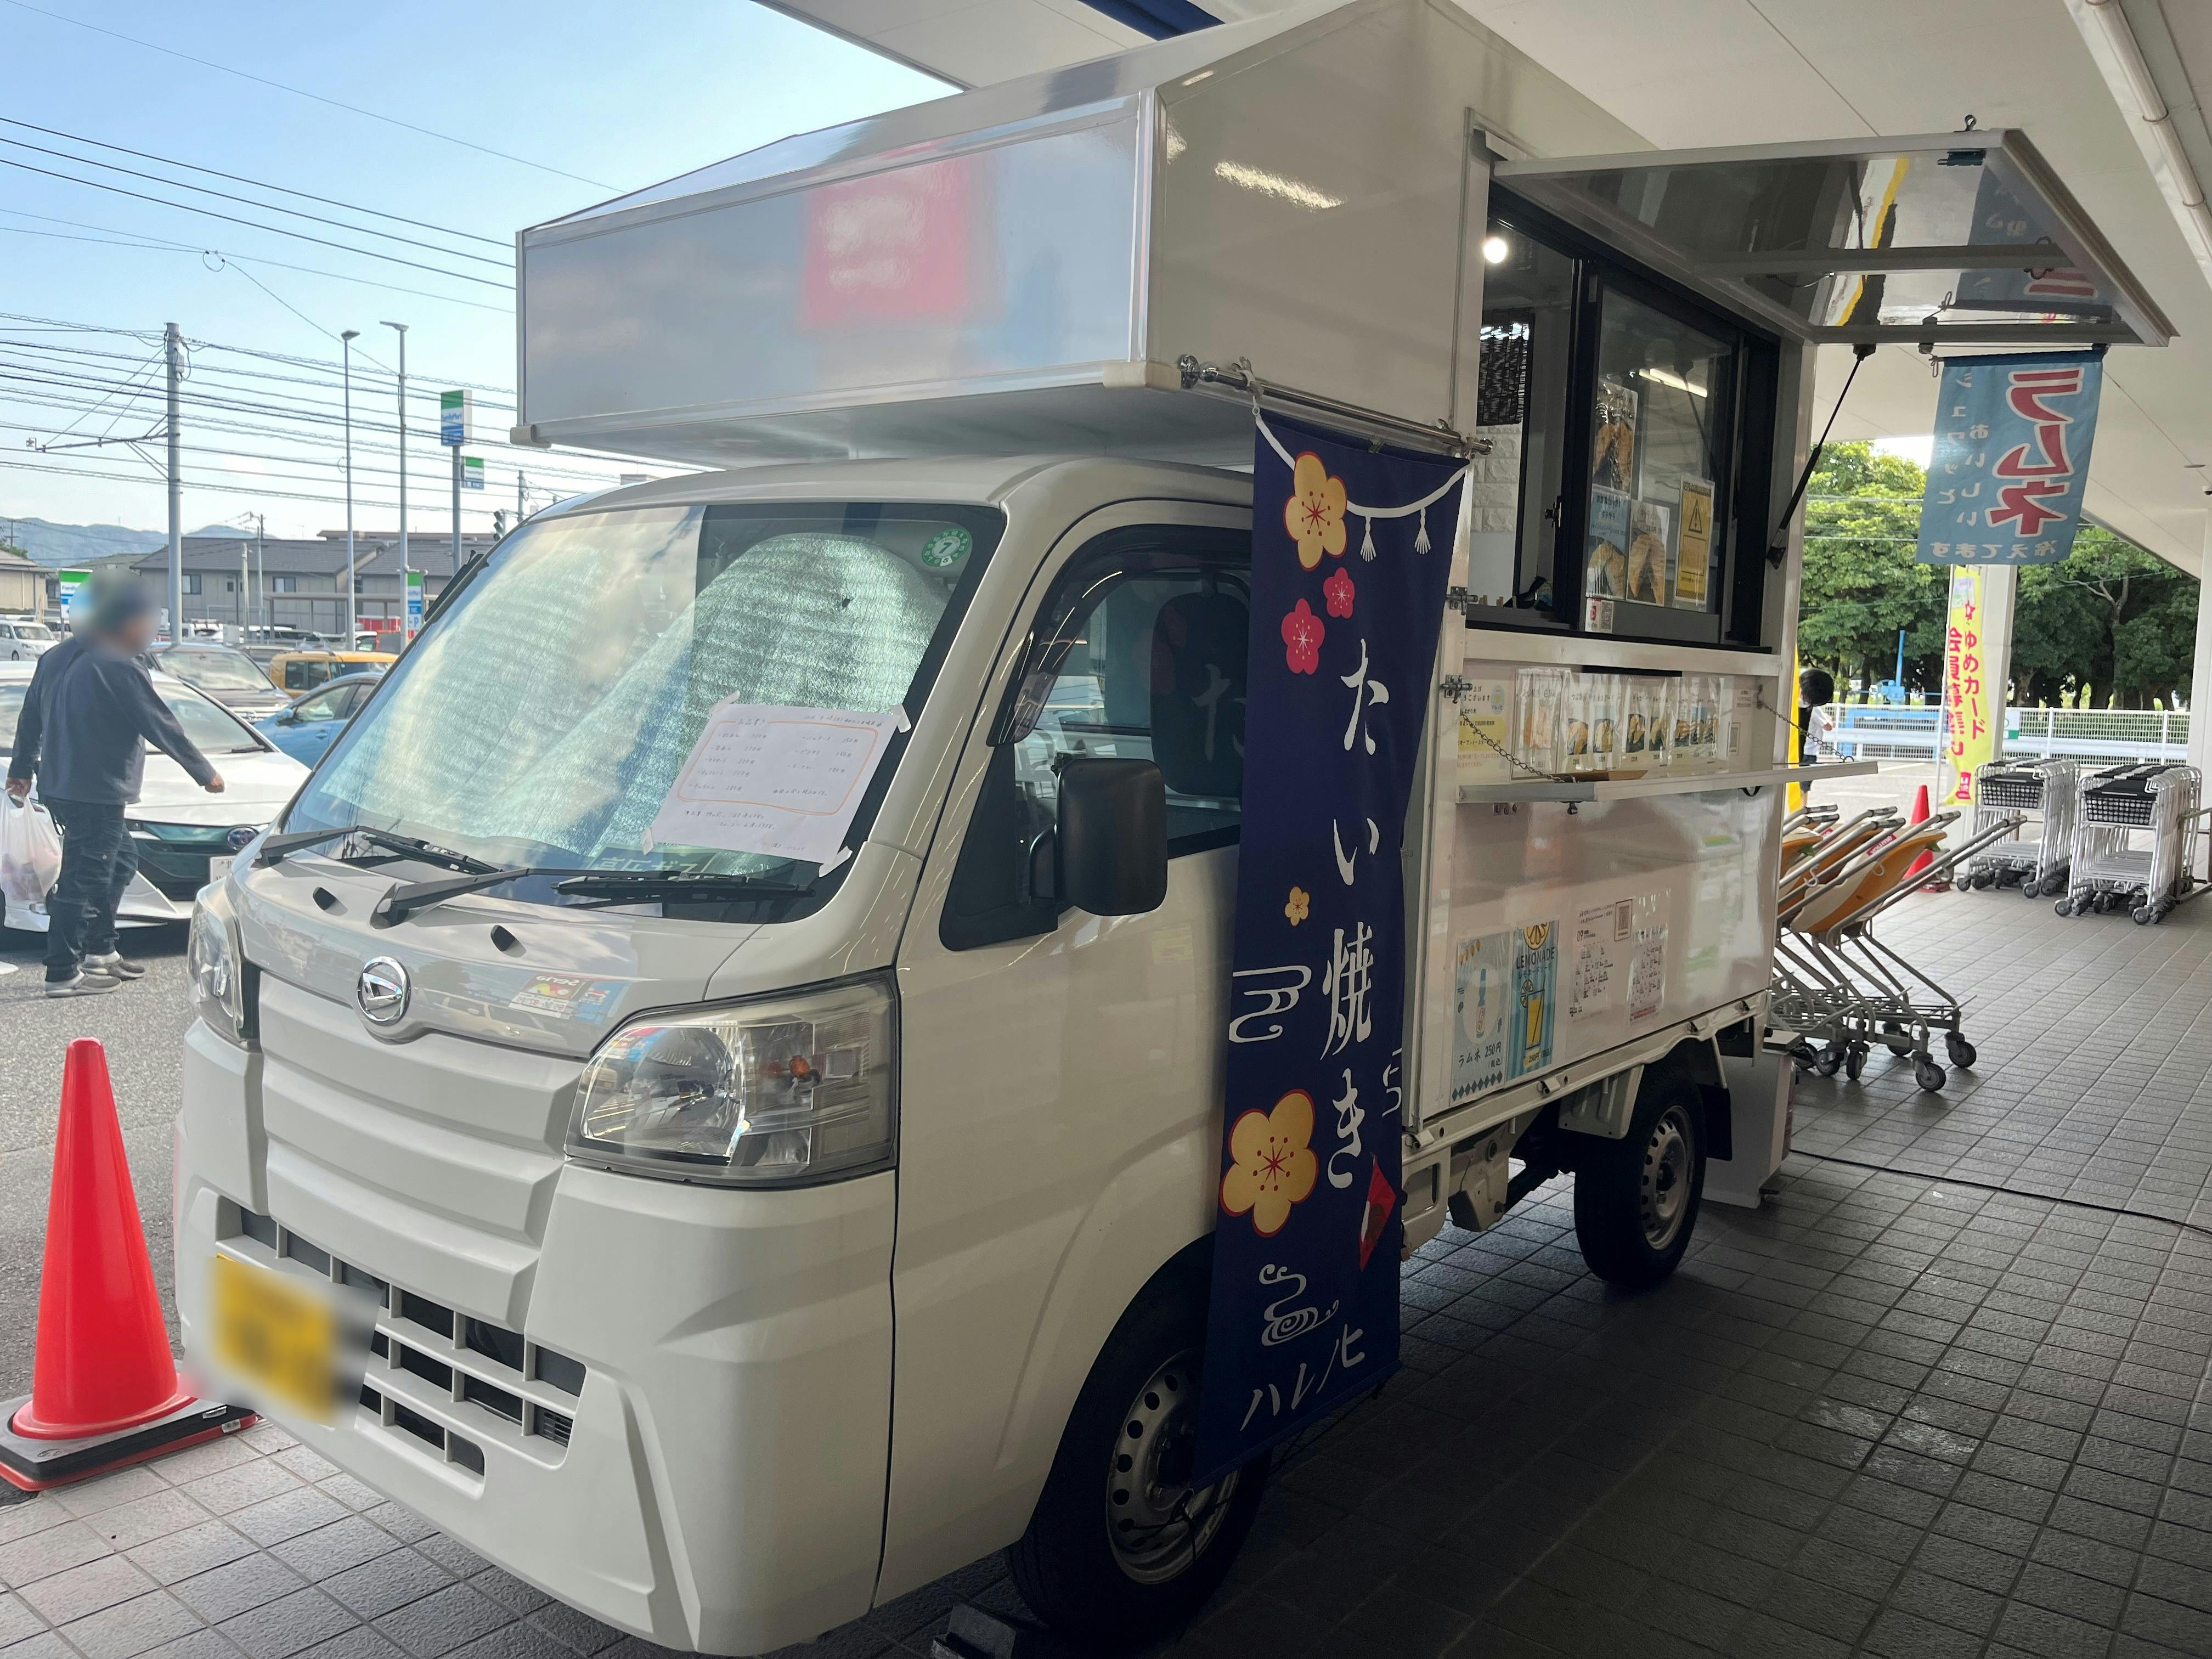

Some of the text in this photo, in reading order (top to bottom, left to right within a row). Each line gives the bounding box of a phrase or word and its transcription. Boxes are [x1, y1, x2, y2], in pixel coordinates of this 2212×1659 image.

[939, 542, 953, 554] 7
[1963, 631, 1985, 740] ゆめカード
[1321, 638, 1390, 1189] たい焼き
[1516, 947, 1555, 969] LEMONADE
[1458, 1041, 1502, 1069] ラムネ 250円
[1239, 1324, 1365, 1431] ハレノヒ
